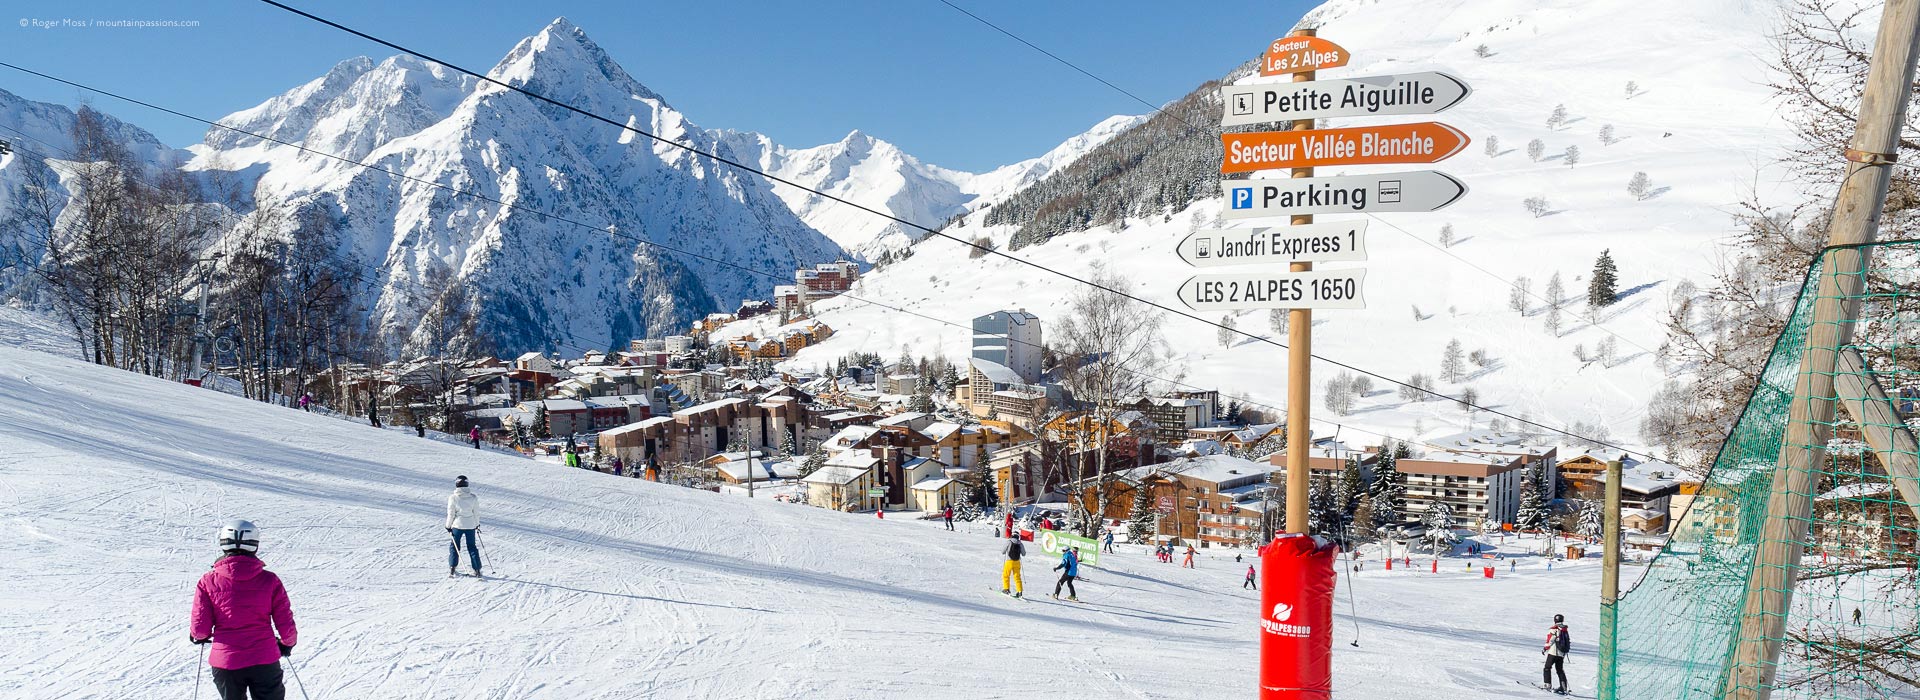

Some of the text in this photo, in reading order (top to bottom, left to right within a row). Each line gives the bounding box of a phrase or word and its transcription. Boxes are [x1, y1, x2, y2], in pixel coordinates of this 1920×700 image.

[1273, 40, 1310, 53] Secteur
[1268, 50, 1338, 72] Les 2 Alpes
[1264, 81, 1434, 113] Petite Aiguille
[1230, 132, 1434, 164] Secteur Vallée Blanche
[1263, 184, 1366, 209] Parking
[1217, 230, 1356, 259] Jandri Express 1
[1196, 278, 1355, 302] LES 2 ALPES 1650
